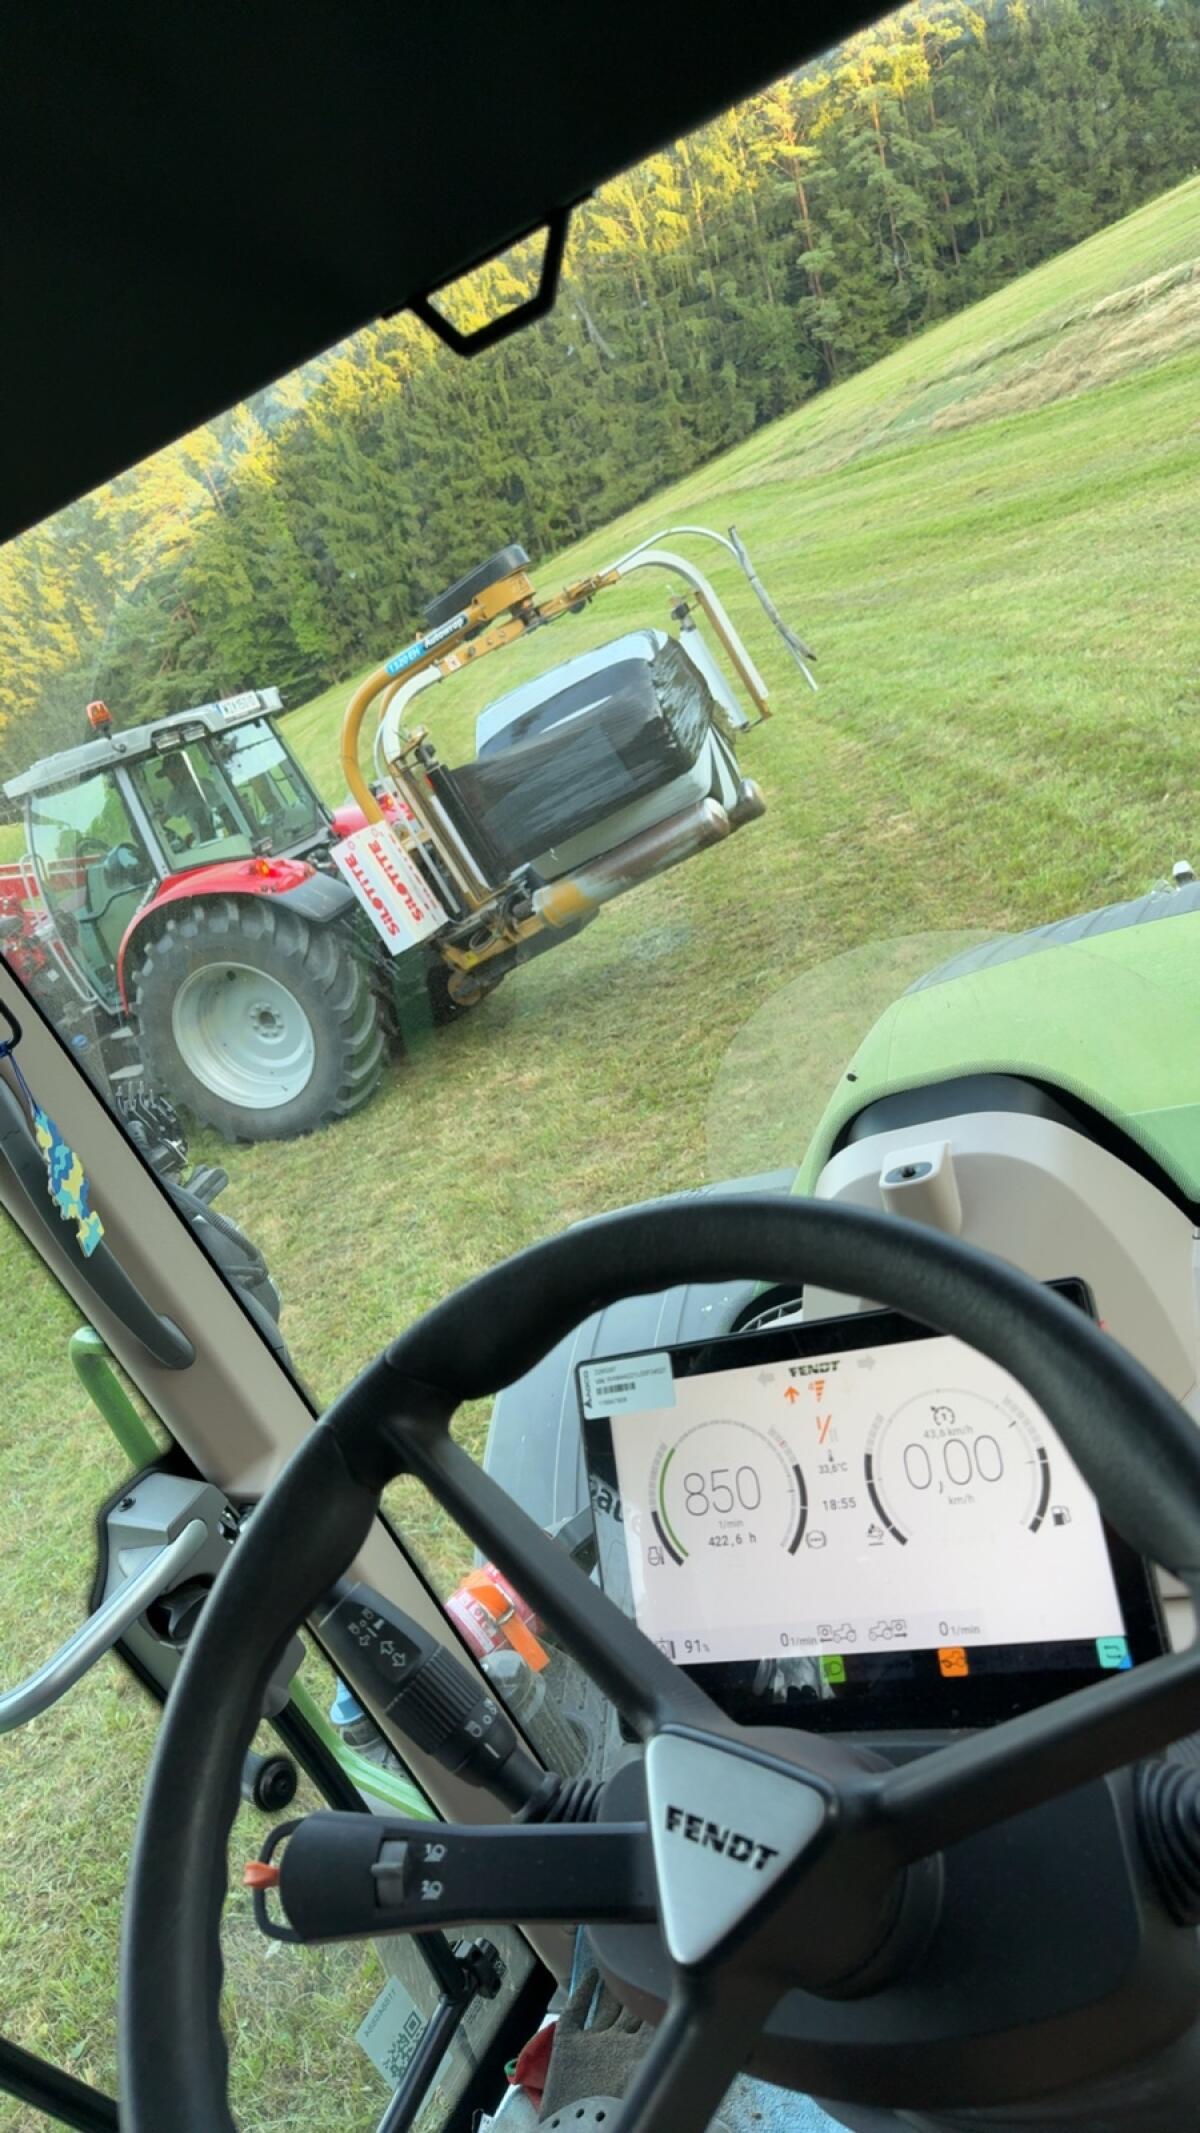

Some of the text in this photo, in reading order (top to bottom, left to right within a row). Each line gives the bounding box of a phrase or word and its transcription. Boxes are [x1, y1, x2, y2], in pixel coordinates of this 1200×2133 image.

[788, 1360, 841, 1377] FENDT
[947, 1424, 974, 1436] km/h
[903, 1435, 1004, 1494] 0,00
[683, 1465, 761, 1517] 850
[822, 1497, 857, 1512] 18:55
[948, 1494, 975, 1505] km/h
[748, 1532, 757, 1543] h
[939, 1621, 981, 1636] 0 1/min
[780, 1633, 789, 1647] 0
[665, 1804, 779, 1870] FENDT
